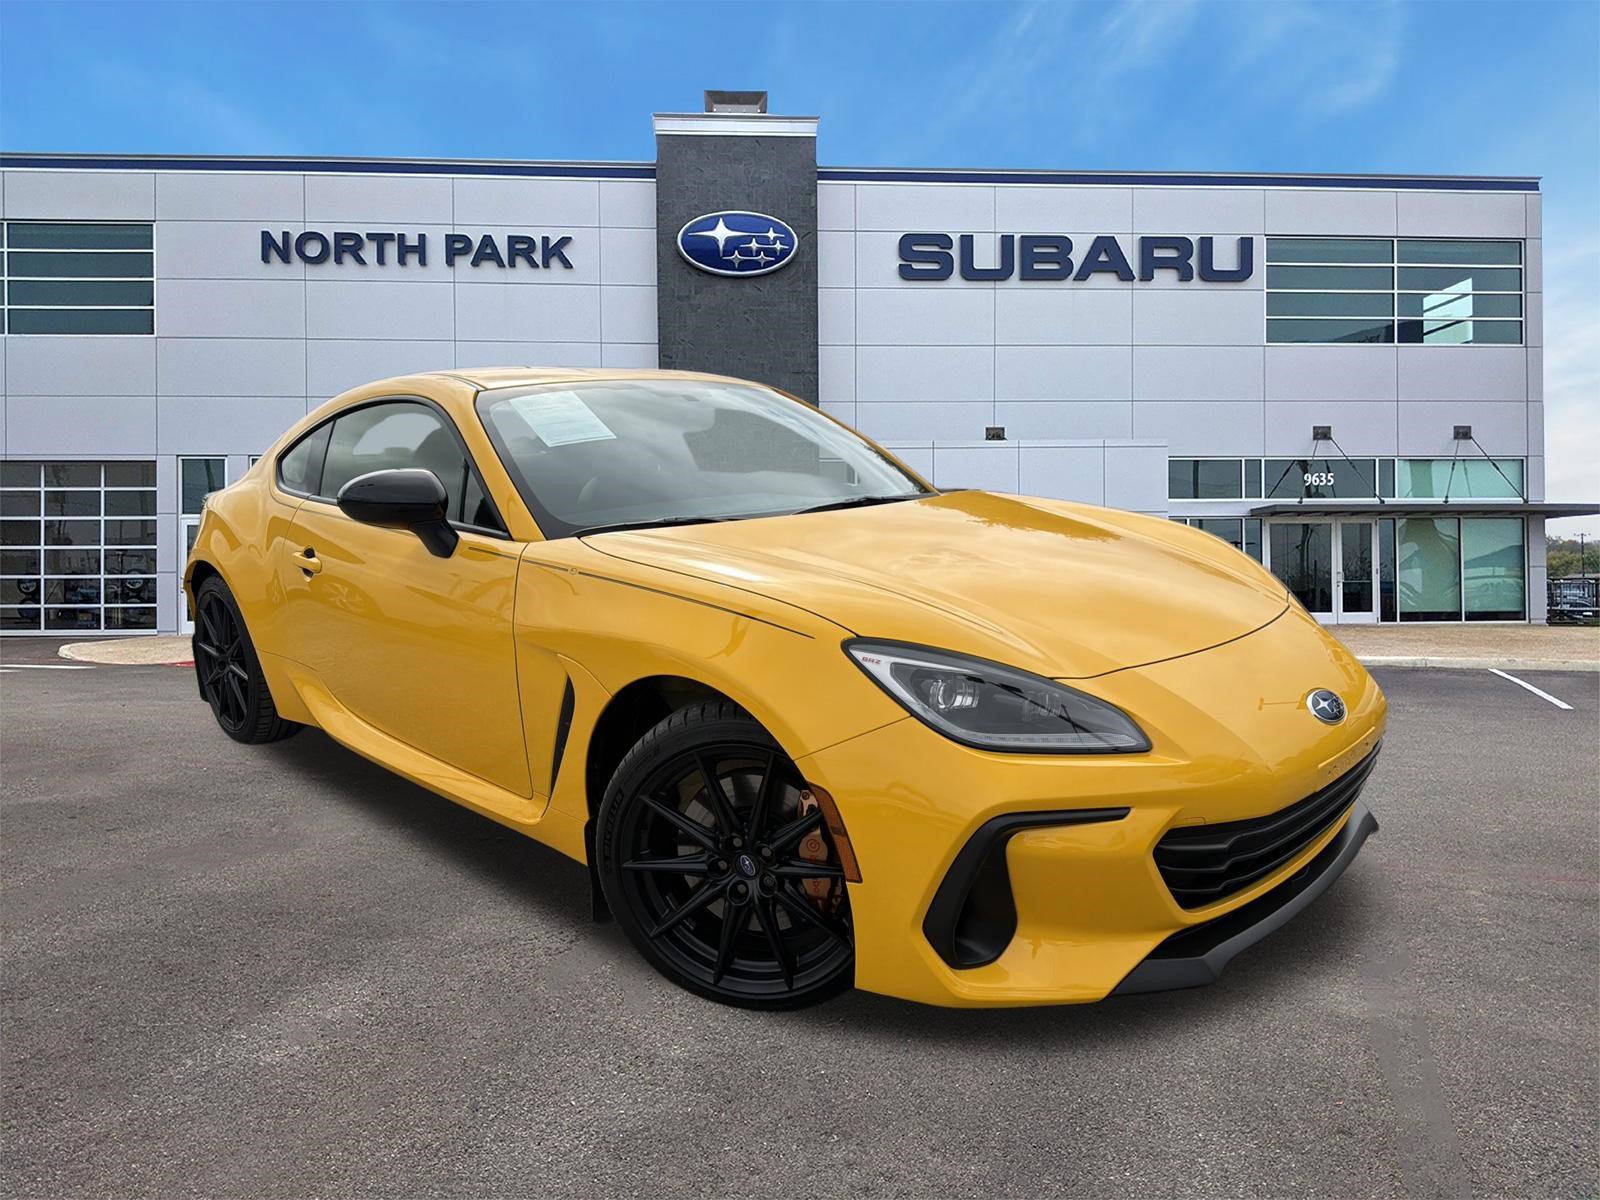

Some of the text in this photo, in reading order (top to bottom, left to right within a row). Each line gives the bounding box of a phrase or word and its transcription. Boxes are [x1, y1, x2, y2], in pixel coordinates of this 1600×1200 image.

[261, 231, 574, 269] NORTH PARK
[898, 233, 1254, 282] SUBARU
[1303, 472, 1335, 486] 9635
